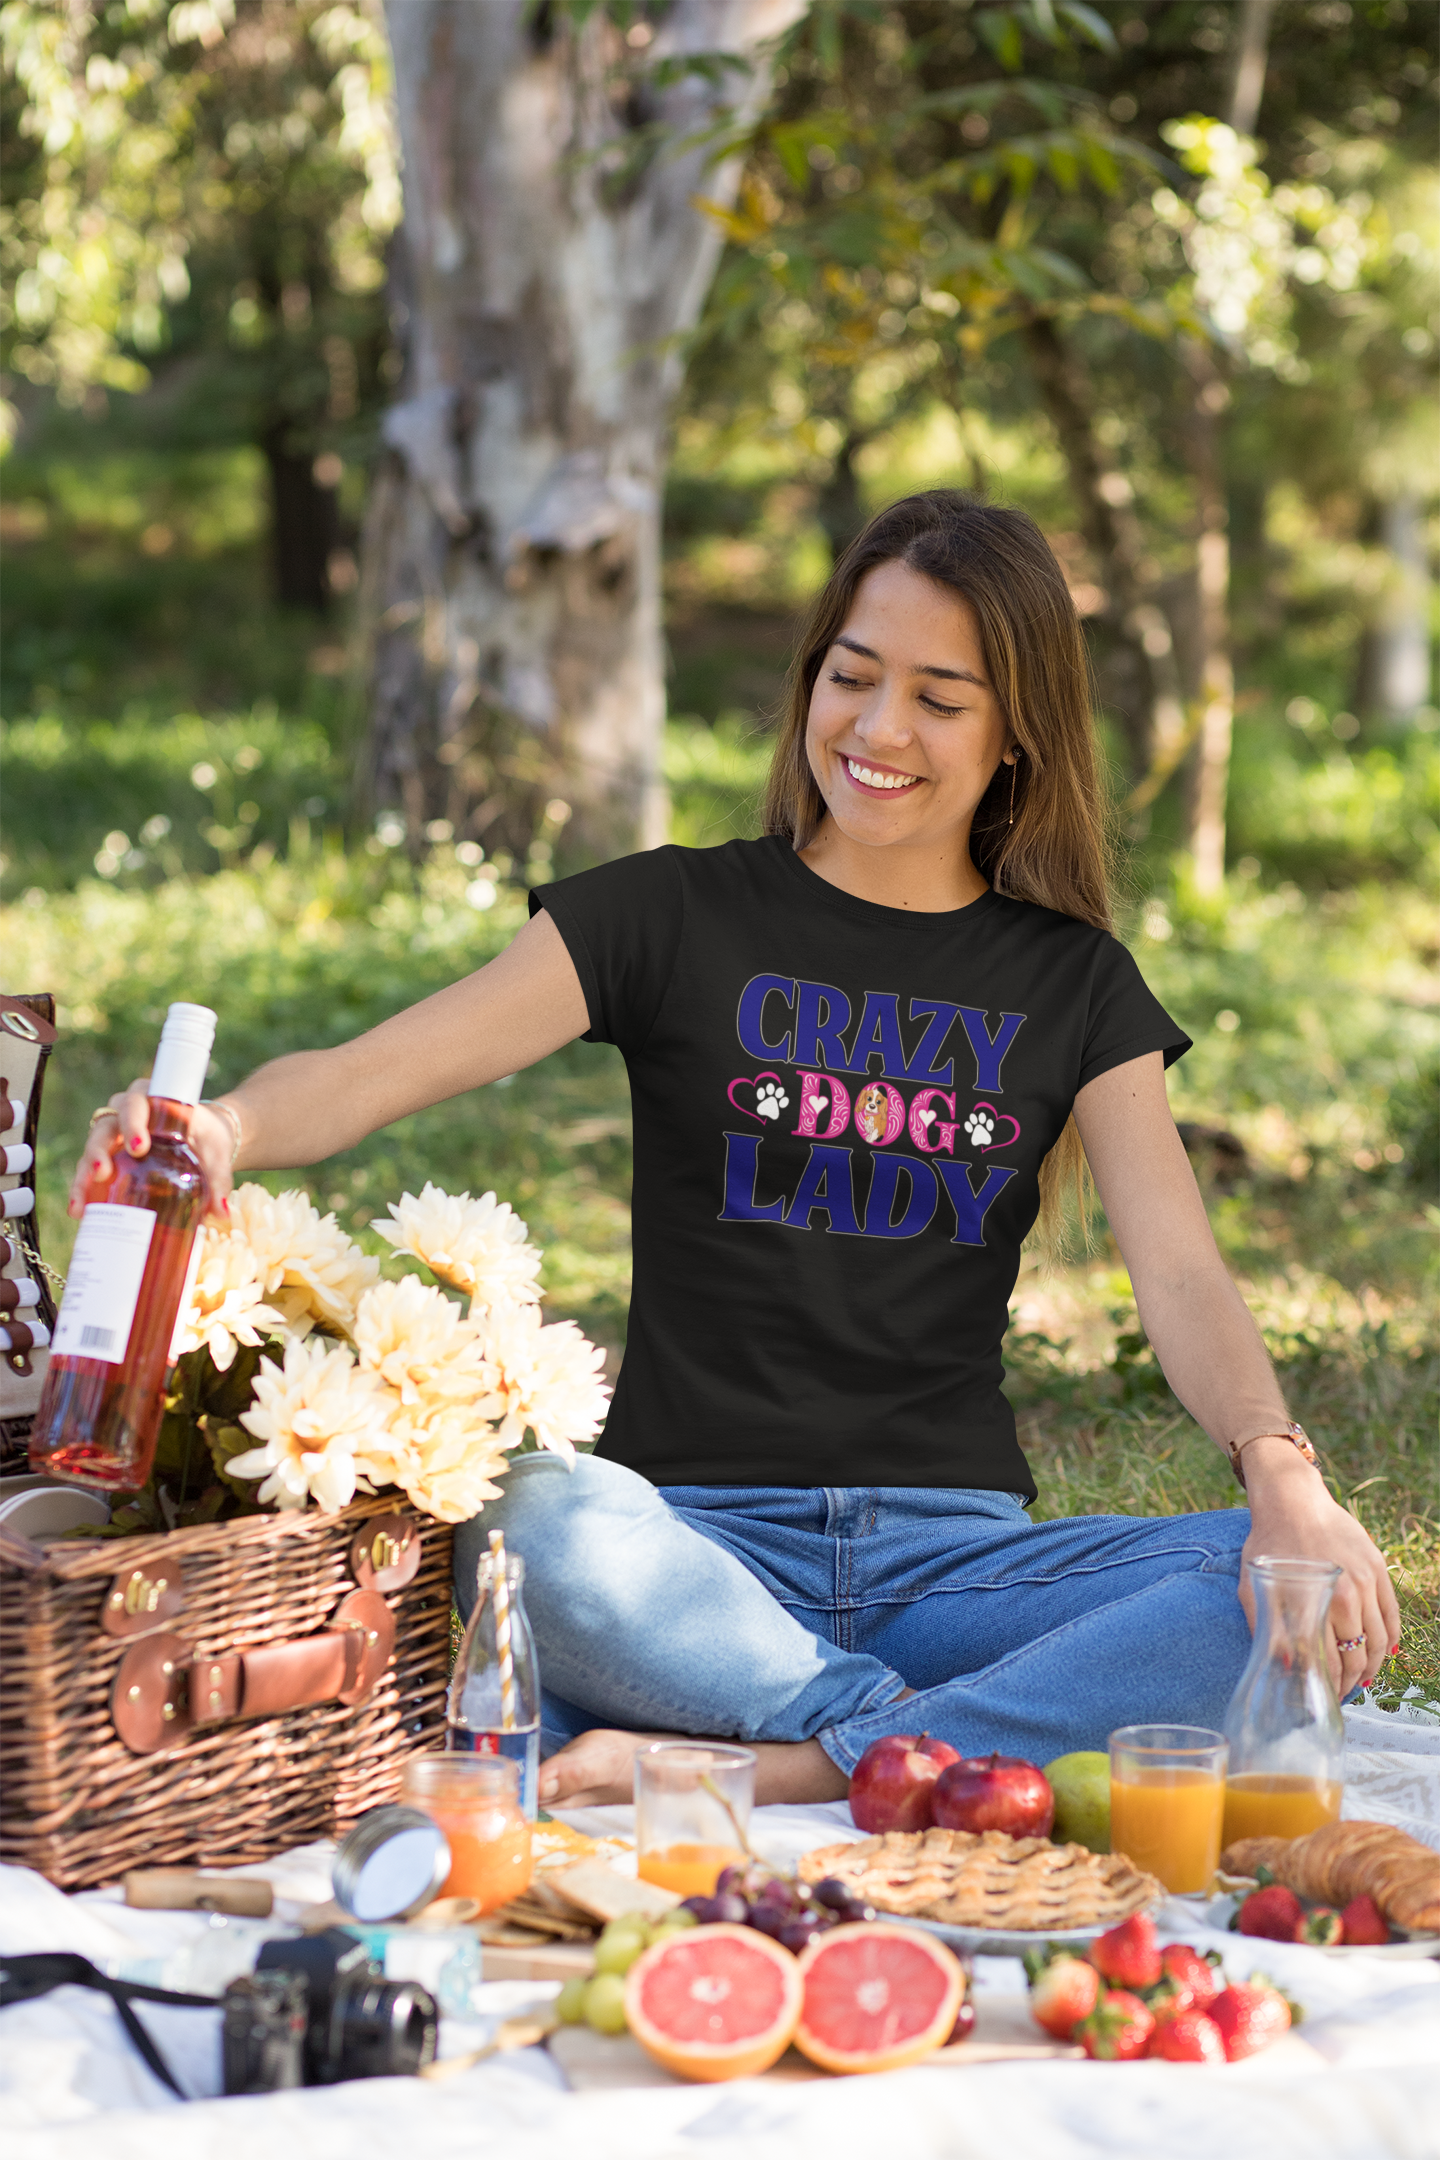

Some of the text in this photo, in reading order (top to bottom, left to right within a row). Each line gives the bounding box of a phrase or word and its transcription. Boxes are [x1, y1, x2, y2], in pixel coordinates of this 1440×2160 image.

[737, 973, 1027, 1093] CRAZY
[791, 1070, 961, 1155] DOG
[717, 1131, 1018, 1246] LADY
